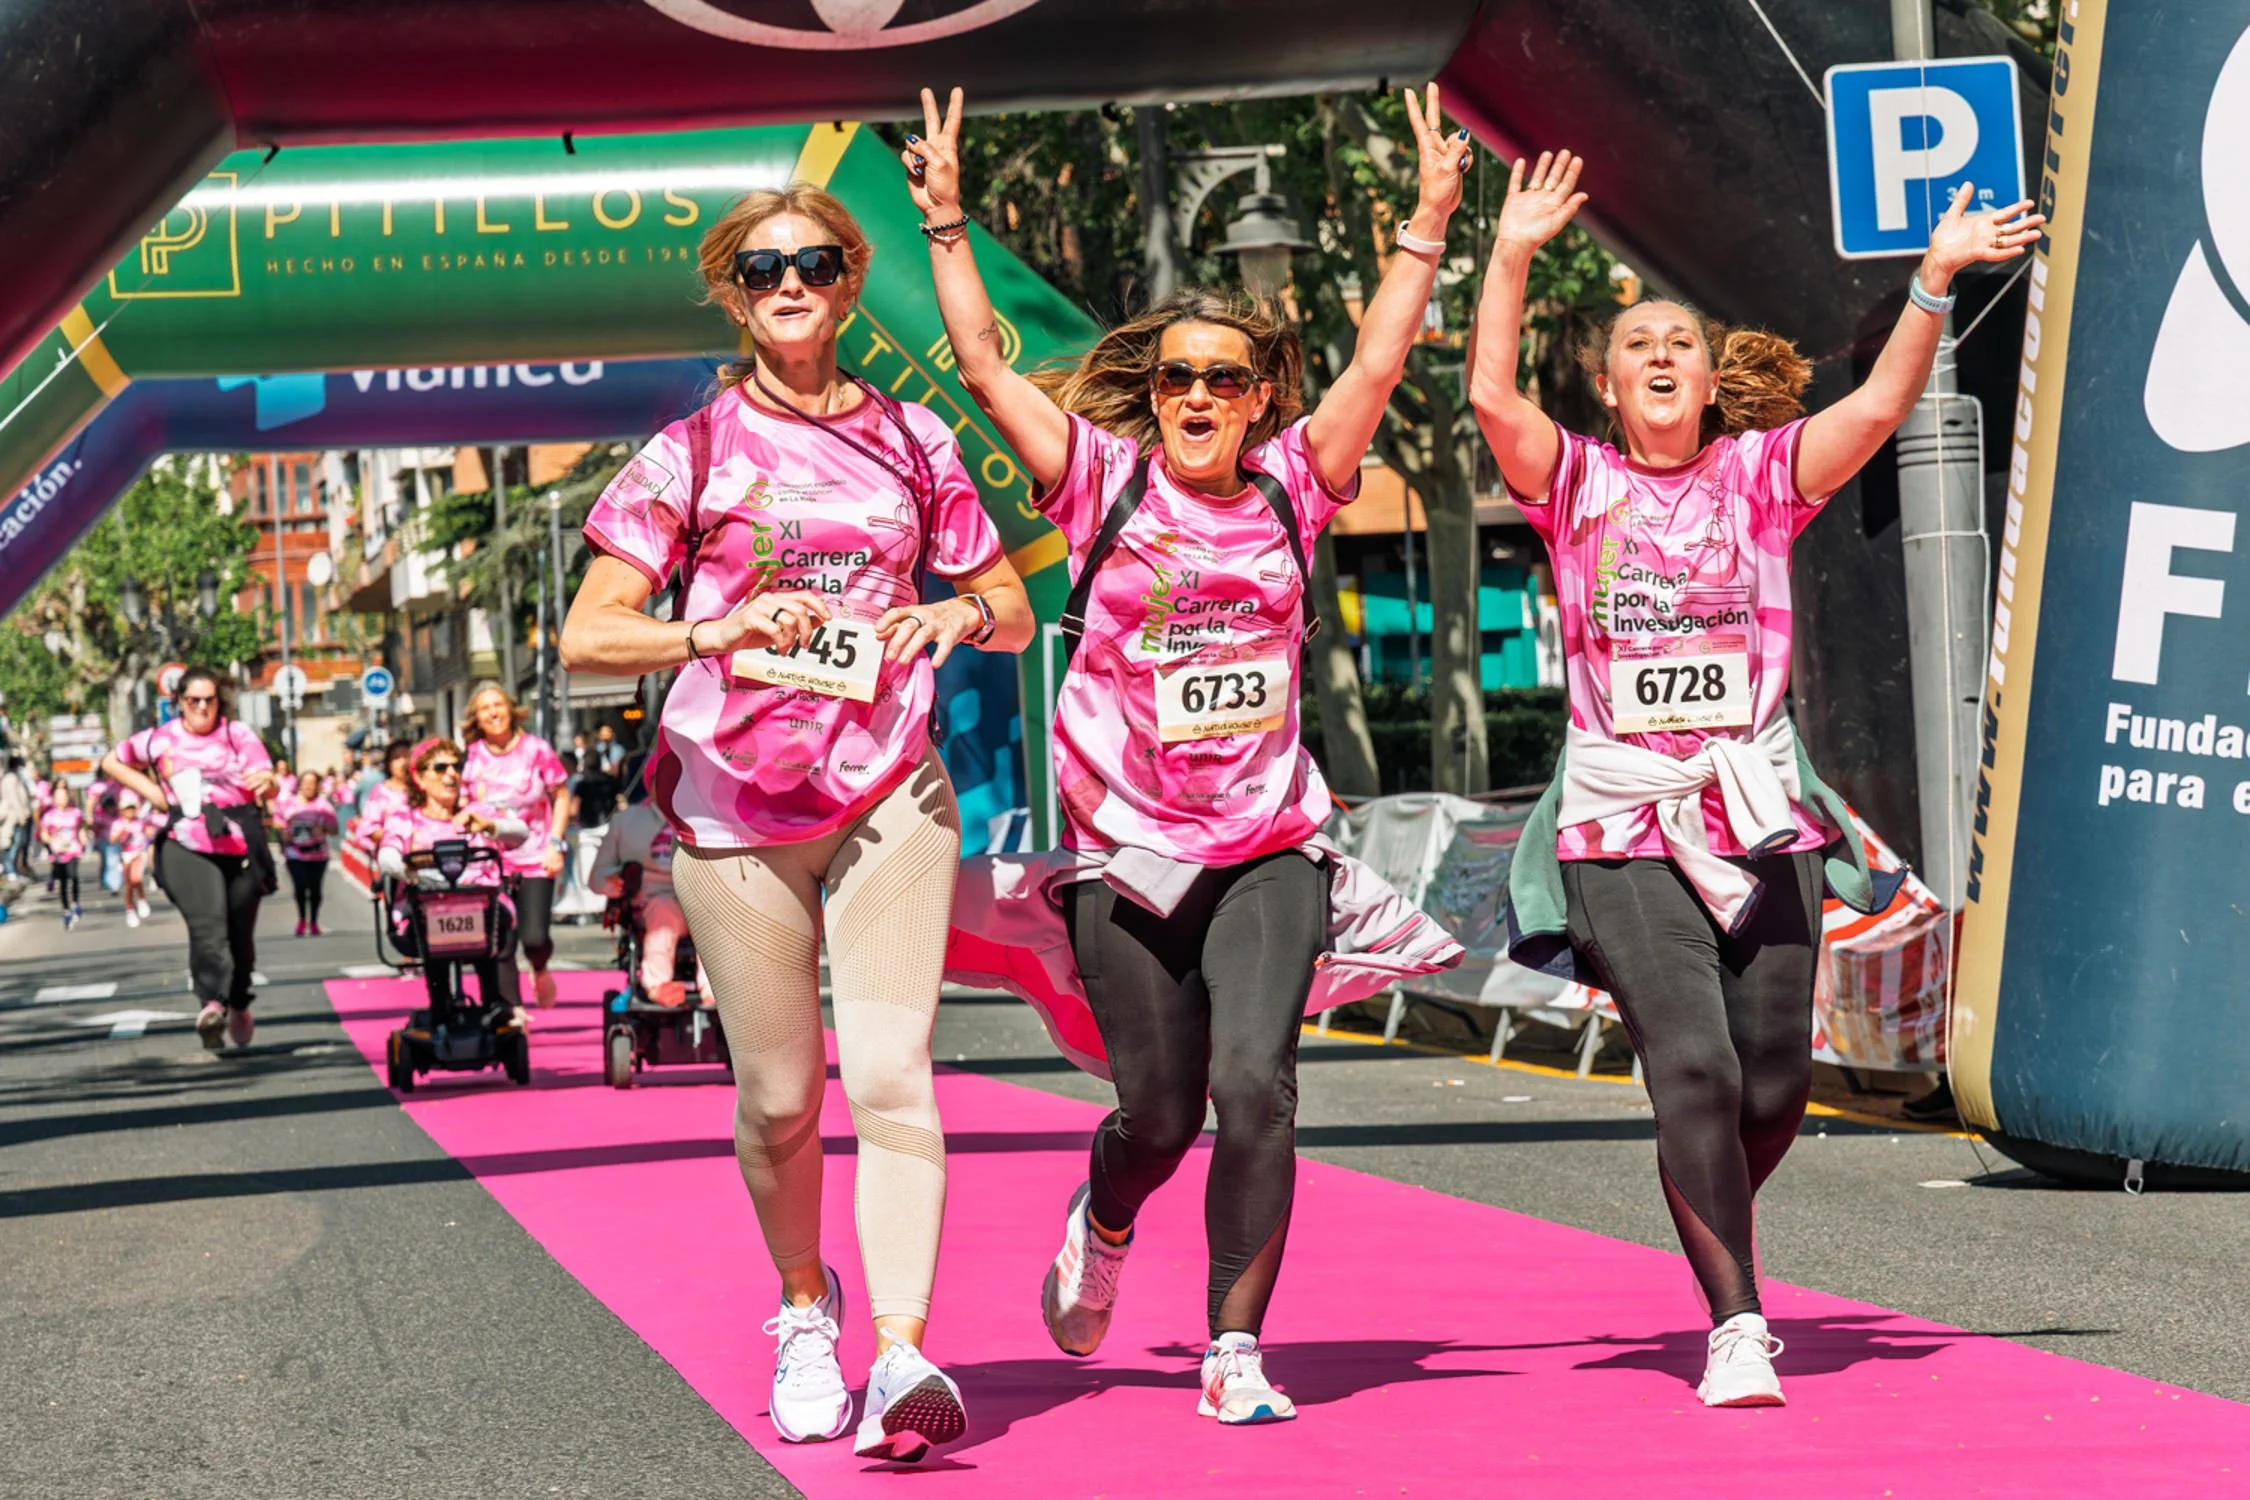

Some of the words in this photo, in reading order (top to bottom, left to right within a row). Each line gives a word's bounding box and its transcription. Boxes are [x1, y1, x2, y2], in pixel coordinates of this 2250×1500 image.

[1868, 86, 1979, 231] P
[1978, 188, 1994, 201] m
[266, 257, 354, 274] HECHO
[373, 256, 404, 272] EN
[421, 249, 526, 271] ESPAÑA
[544, 249, 628, 266] DESDE
[779, 520, 801, 540] XI
[780, 548, 868, 568] Carrera
[1622, 538, 1639, 555] XI
[777, 577, 816, 590] por
[821, 574, 842, 594] la
[1178, 570, 1199, 590] XI
[1592, 536, 1619, 632] mujer
[1617, 563, 1688, 590] Carrera
[1614, 592, 1650, 611] por
[1654, 593, 1670, 613] la
[2112, 501, 2237, 685] F
[1141, 564, 1174, 653] mujer
[1174, 596, 1255, 614] Carrera
[1168, 622, 1204, 637] por
[1208, 617, 1225, 633] la
[1182, 672, 1267, 712] 6733
[1635, 664, 1726, 706] 6728
[2105, 702, 2250, 760] Funda
[2098, 764, 2205, 810] para
[437, 916, 475, 934] 1628
